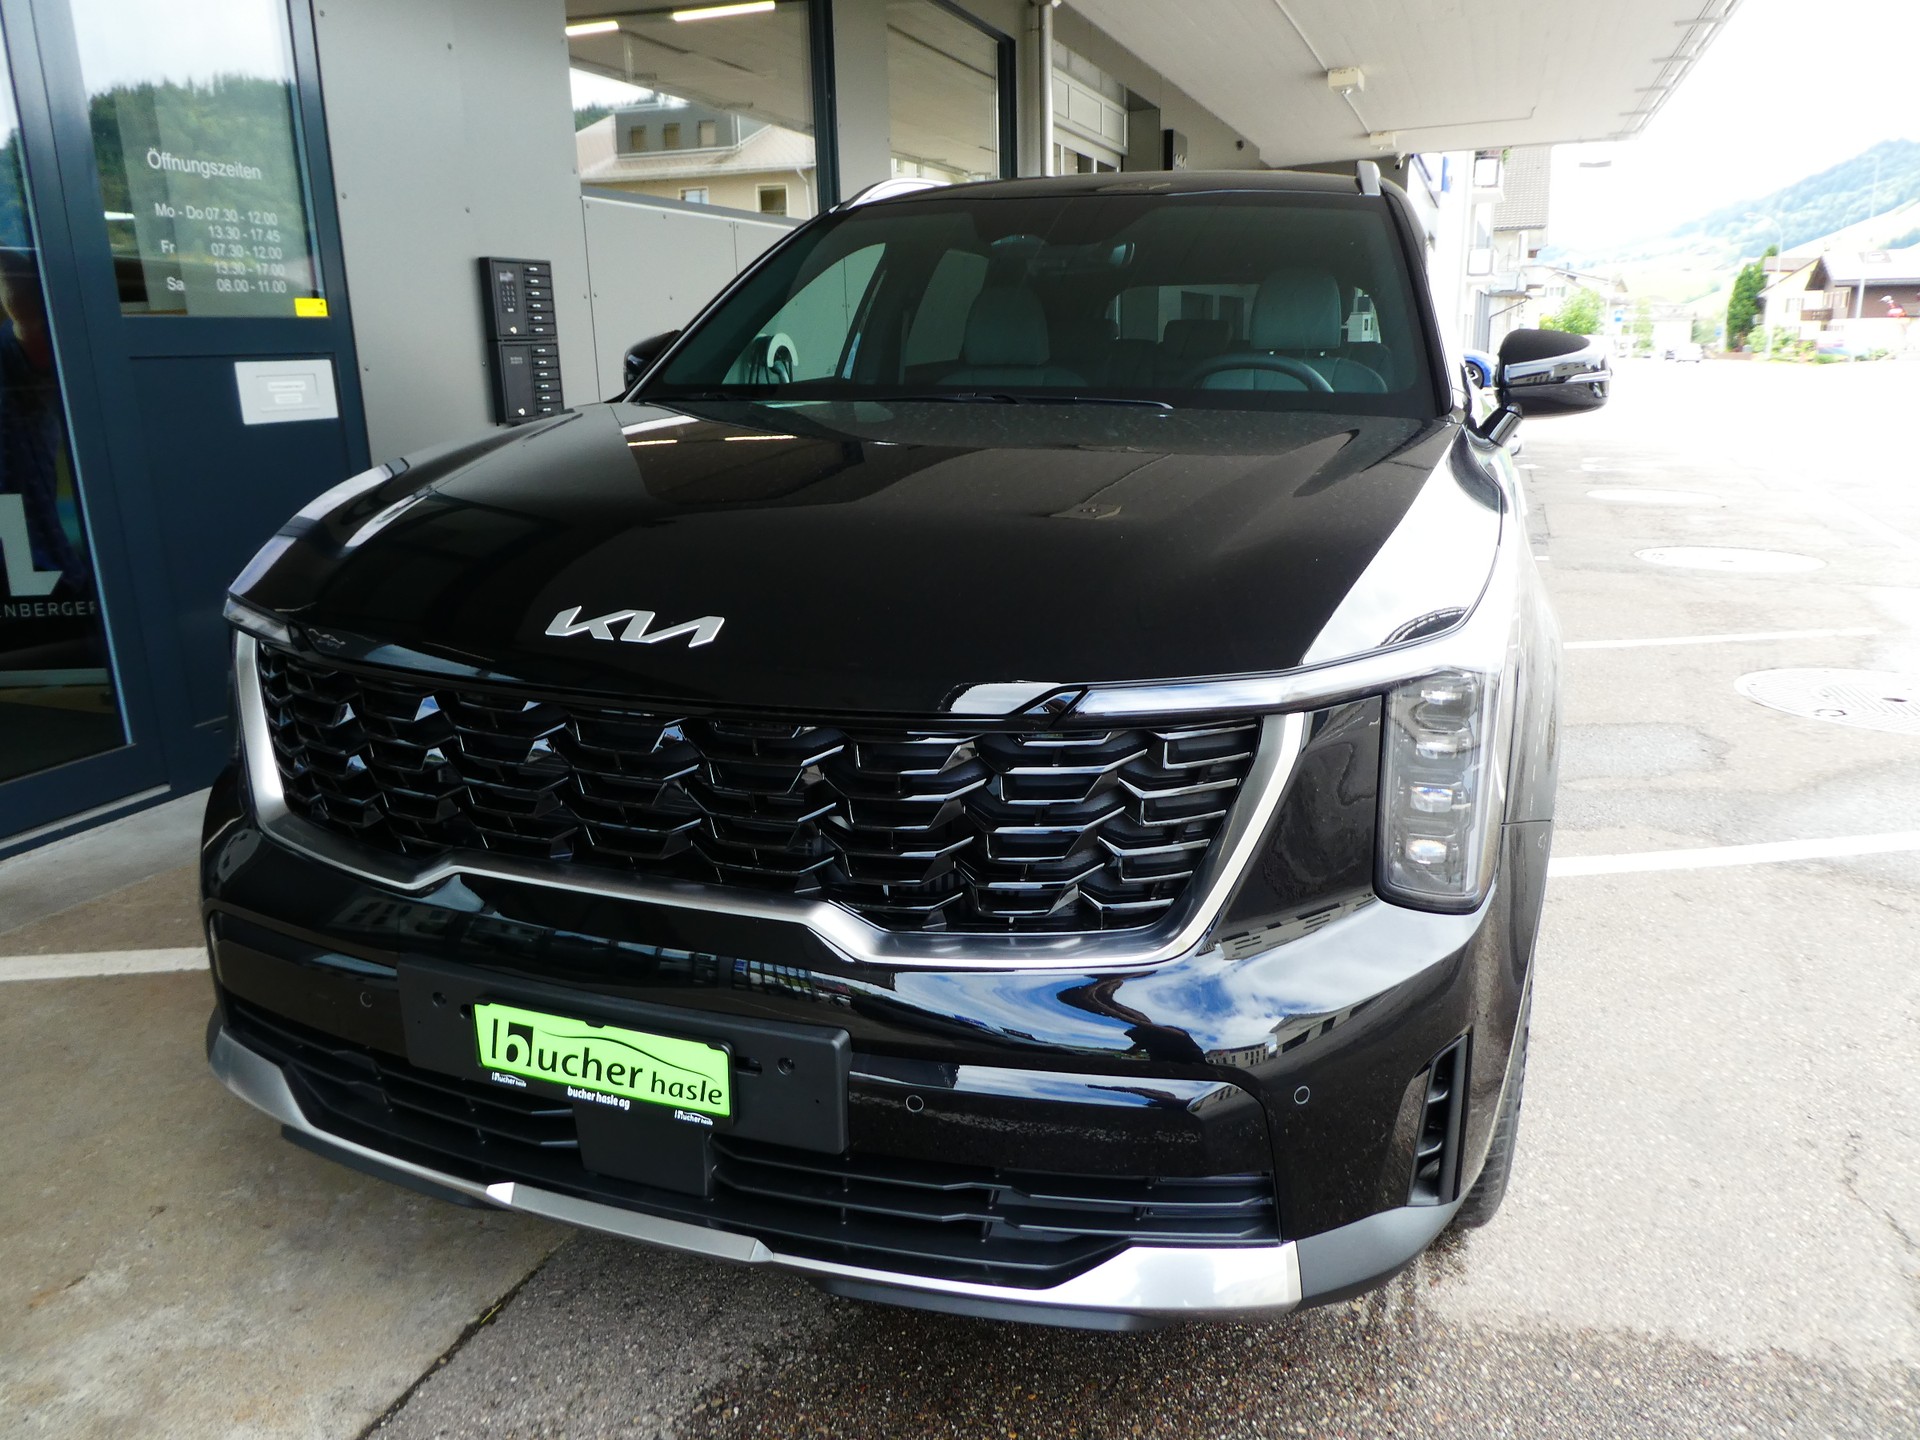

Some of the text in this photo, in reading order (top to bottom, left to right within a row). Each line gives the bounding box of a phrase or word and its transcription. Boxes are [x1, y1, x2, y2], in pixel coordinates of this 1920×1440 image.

[147, 147, 262, 180] Öffnungszeiten
[155, 202, 175, 218] Mo
[186, 205, 204, 219] Do
[205, 207, 239, 223] 07.30
[248, 211, 278, 226] 12.00
[208, 225, 240, 240] 13.30
[250, 228, 281, 243] 17.45
[161, 240, 175, 254] Fr
[211, 242, 244, 258] 07.30
[253, 245, 283, 260] 12.00
[166, 276, 185, 291] Sa
[258, 280, 287, 293] 11.00
[0, 601, 96, 618] NBERGE
[544, 605, 725, 648] KIA
[567, 1086, 631, 1111] bucher hasle ag
[650, 1071, 723, 1105] hasle
